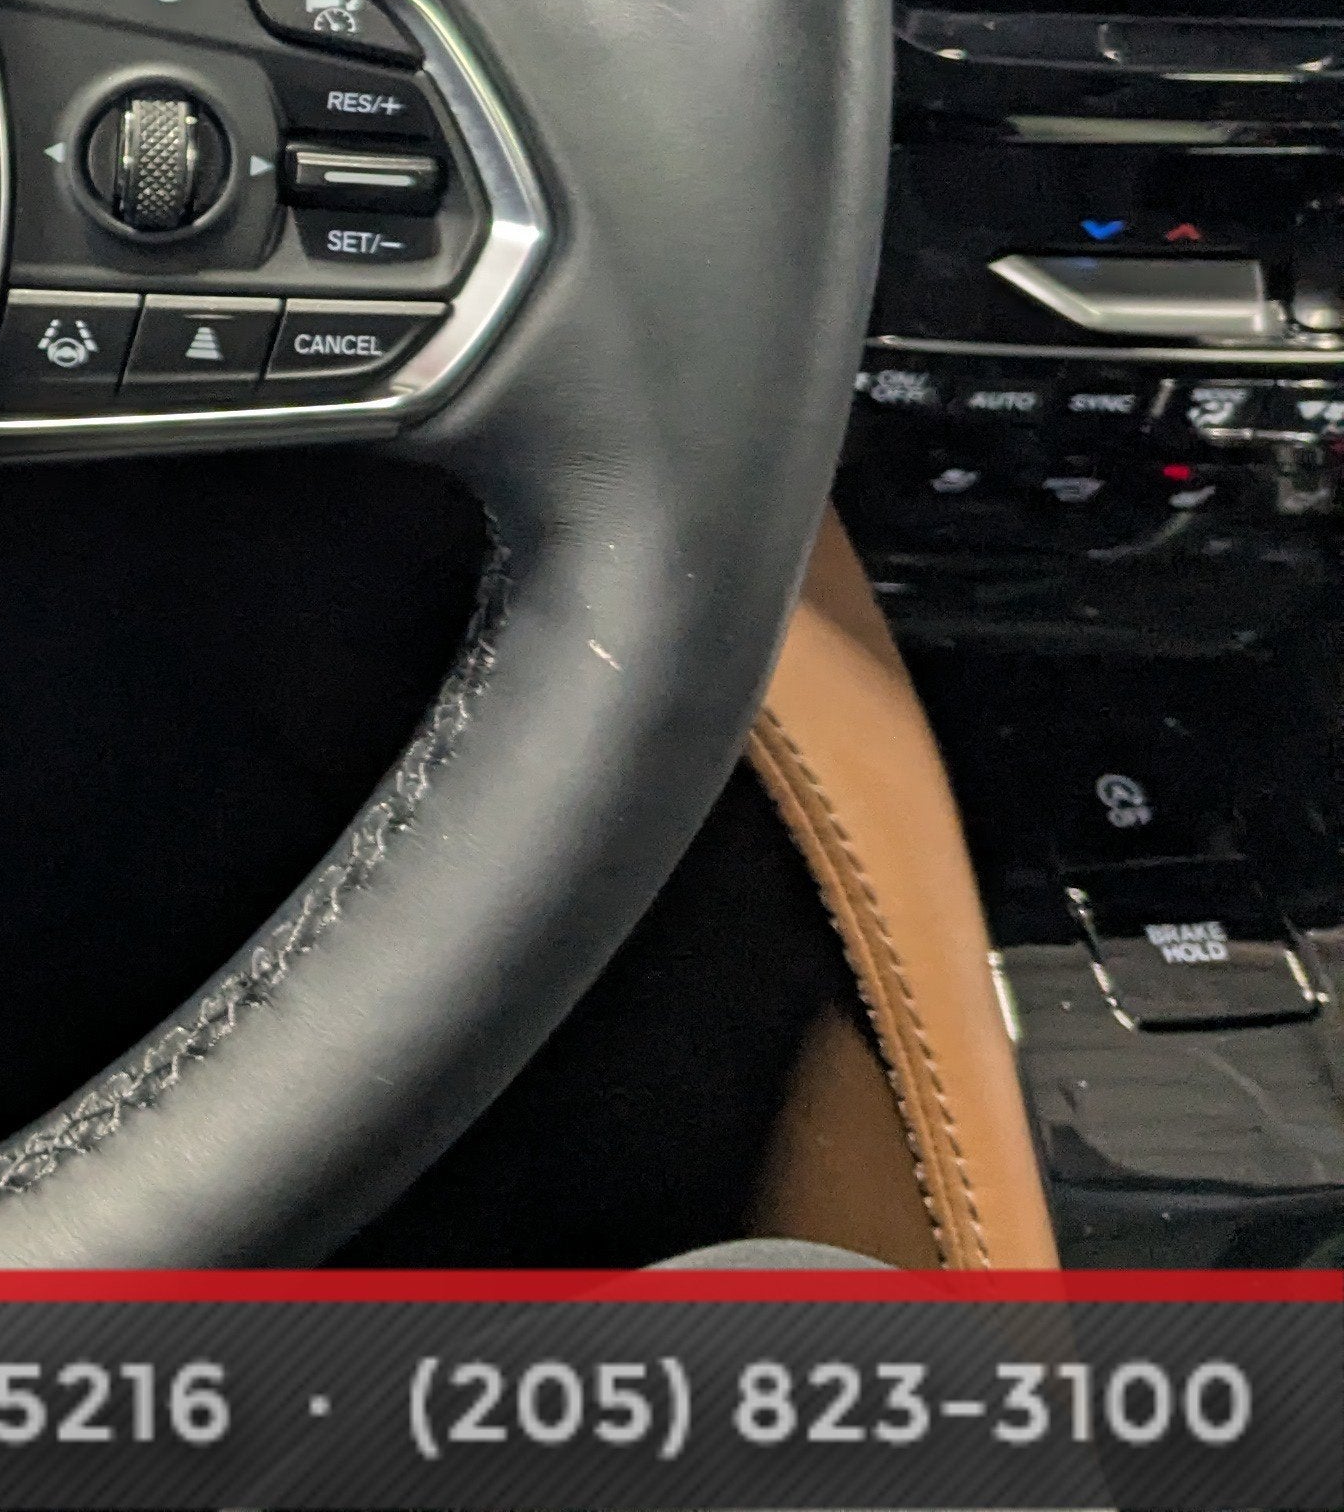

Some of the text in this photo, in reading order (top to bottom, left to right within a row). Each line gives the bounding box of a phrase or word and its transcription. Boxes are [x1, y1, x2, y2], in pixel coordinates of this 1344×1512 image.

[294, 333, 383, 358] CANCEL
[1143, 921, 1228, 945] BRAKE
[1160, 940, 1230, 964] HOLD
